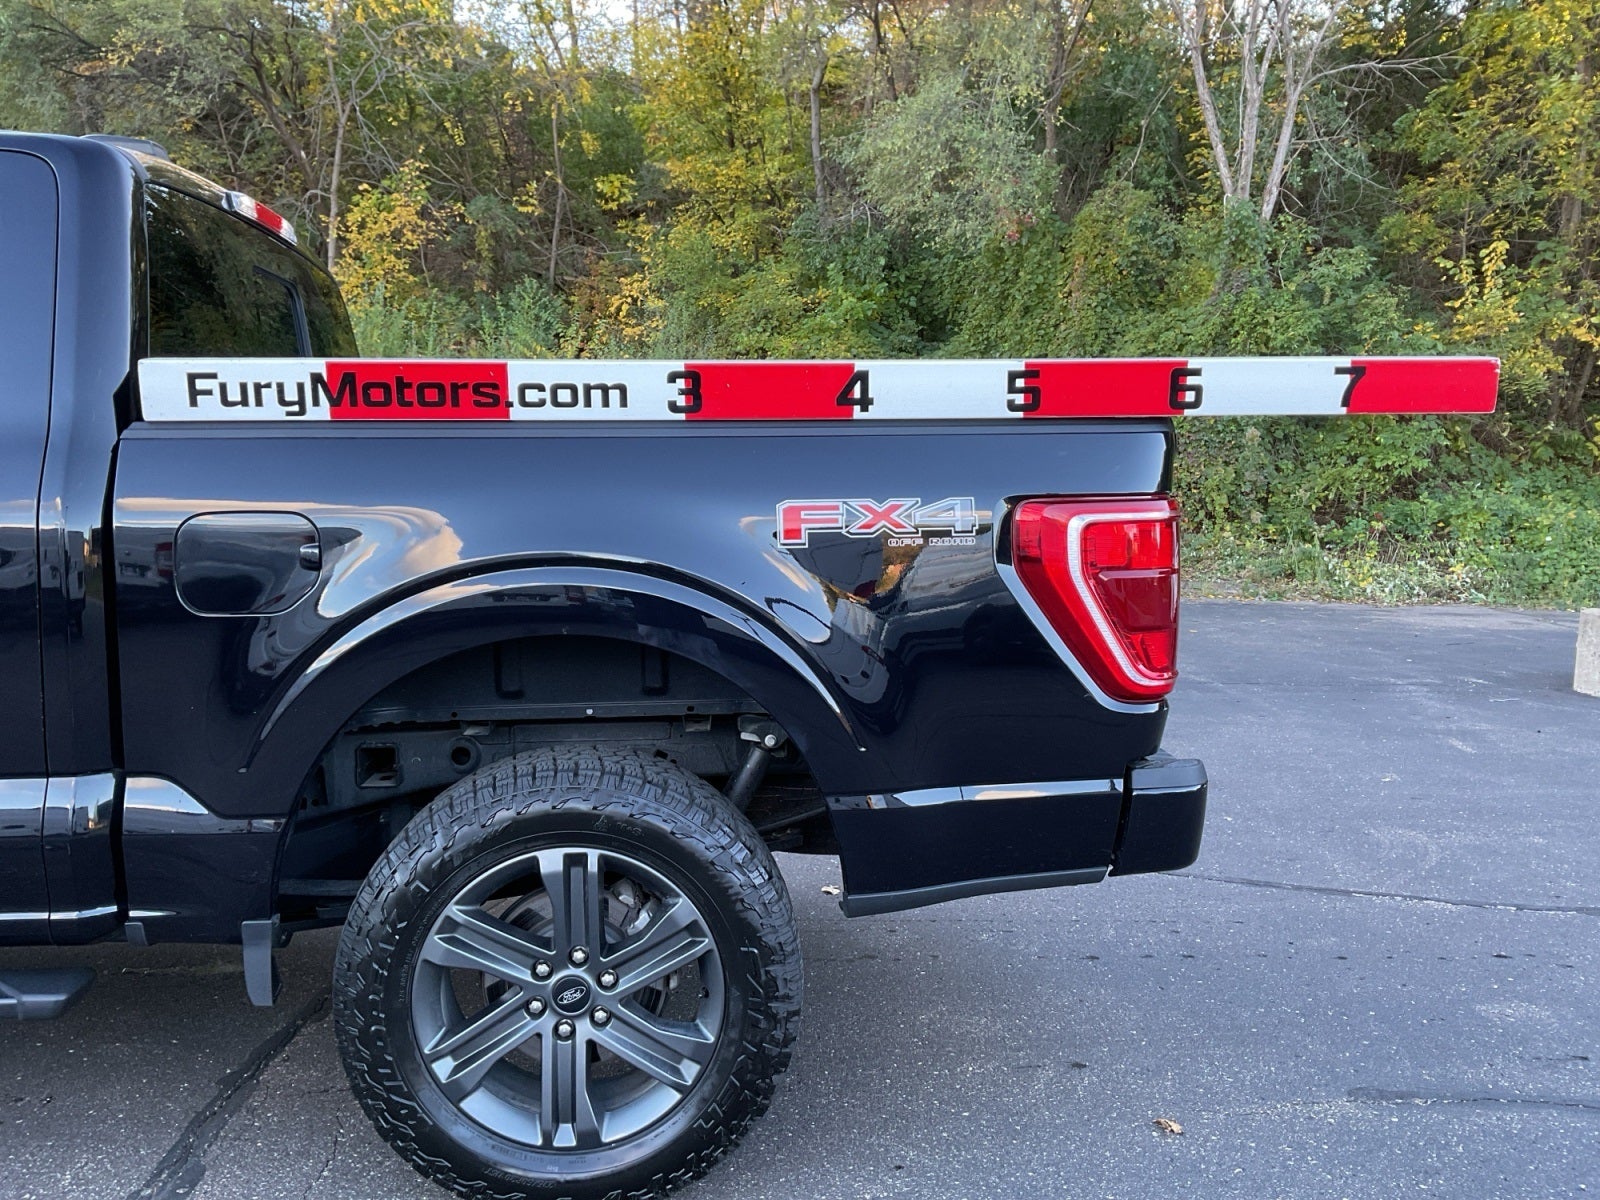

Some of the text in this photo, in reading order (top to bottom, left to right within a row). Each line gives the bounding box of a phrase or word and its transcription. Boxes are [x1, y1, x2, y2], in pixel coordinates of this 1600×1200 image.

[186, 366, 1366, 417] FuryMotors.com 3 4 5 6 7
[776, 497, 978, 548] FX4
[887, 536, 976, 547] OFF ROAD
[561, 989, 582, 1003] Ford
